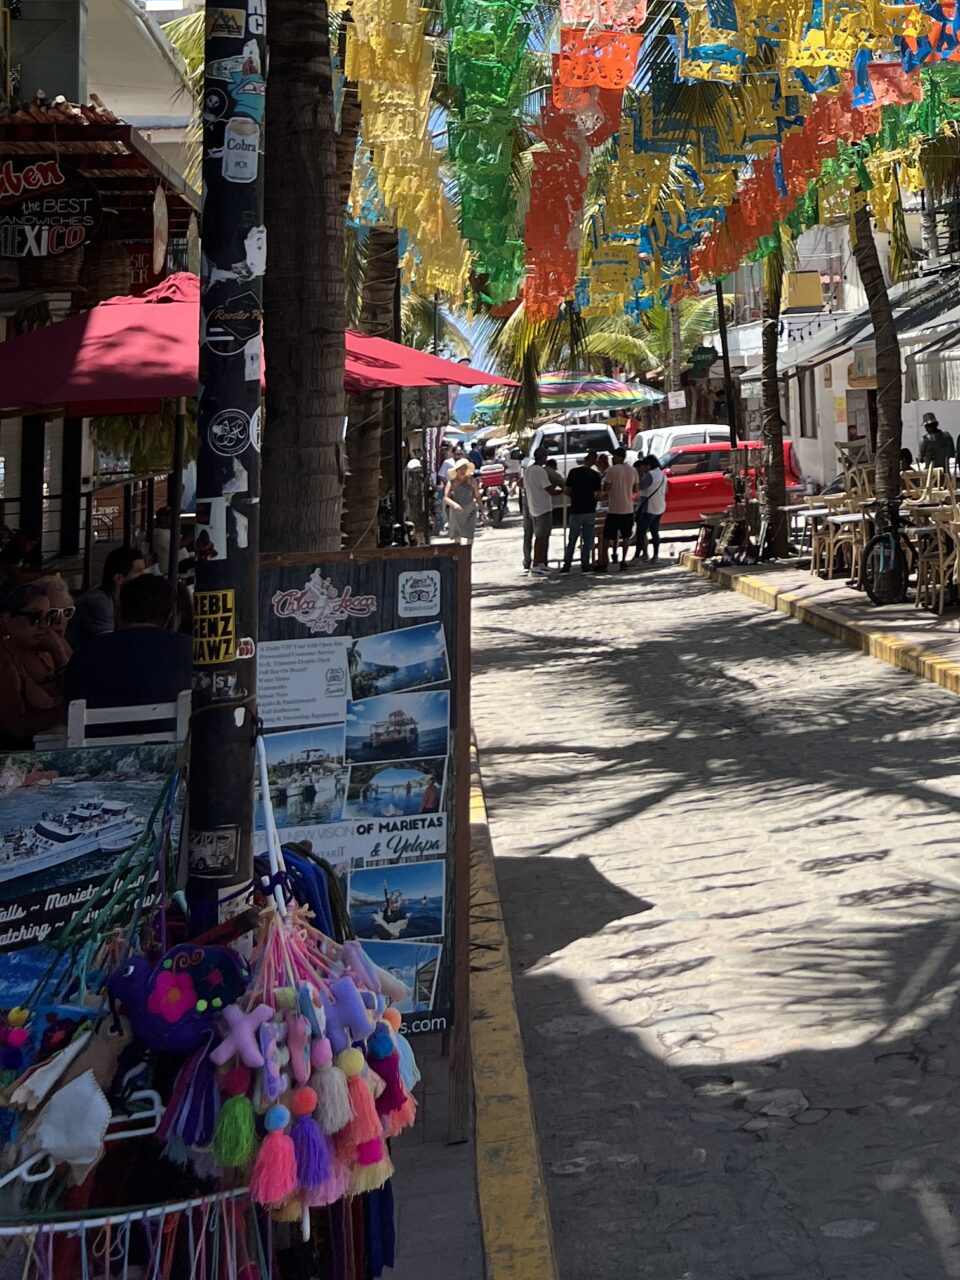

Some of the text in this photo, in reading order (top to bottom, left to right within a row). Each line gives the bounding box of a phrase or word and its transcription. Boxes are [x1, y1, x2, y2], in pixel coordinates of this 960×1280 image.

[227, 138, 257, 152] Cobra
[21, 198, 93, 214] the BEST
[131, 253, 150, 270] SIC
[214, 309, 249, 321] Rooster
[356, 823, 374, 835] OF
[378, 817, 444, 834] MARIETAS
[370, 835, 442, 859] & Yelapa
[0, 923, 52, 946] atching
[400, 1017, 446, 1035] s.com
